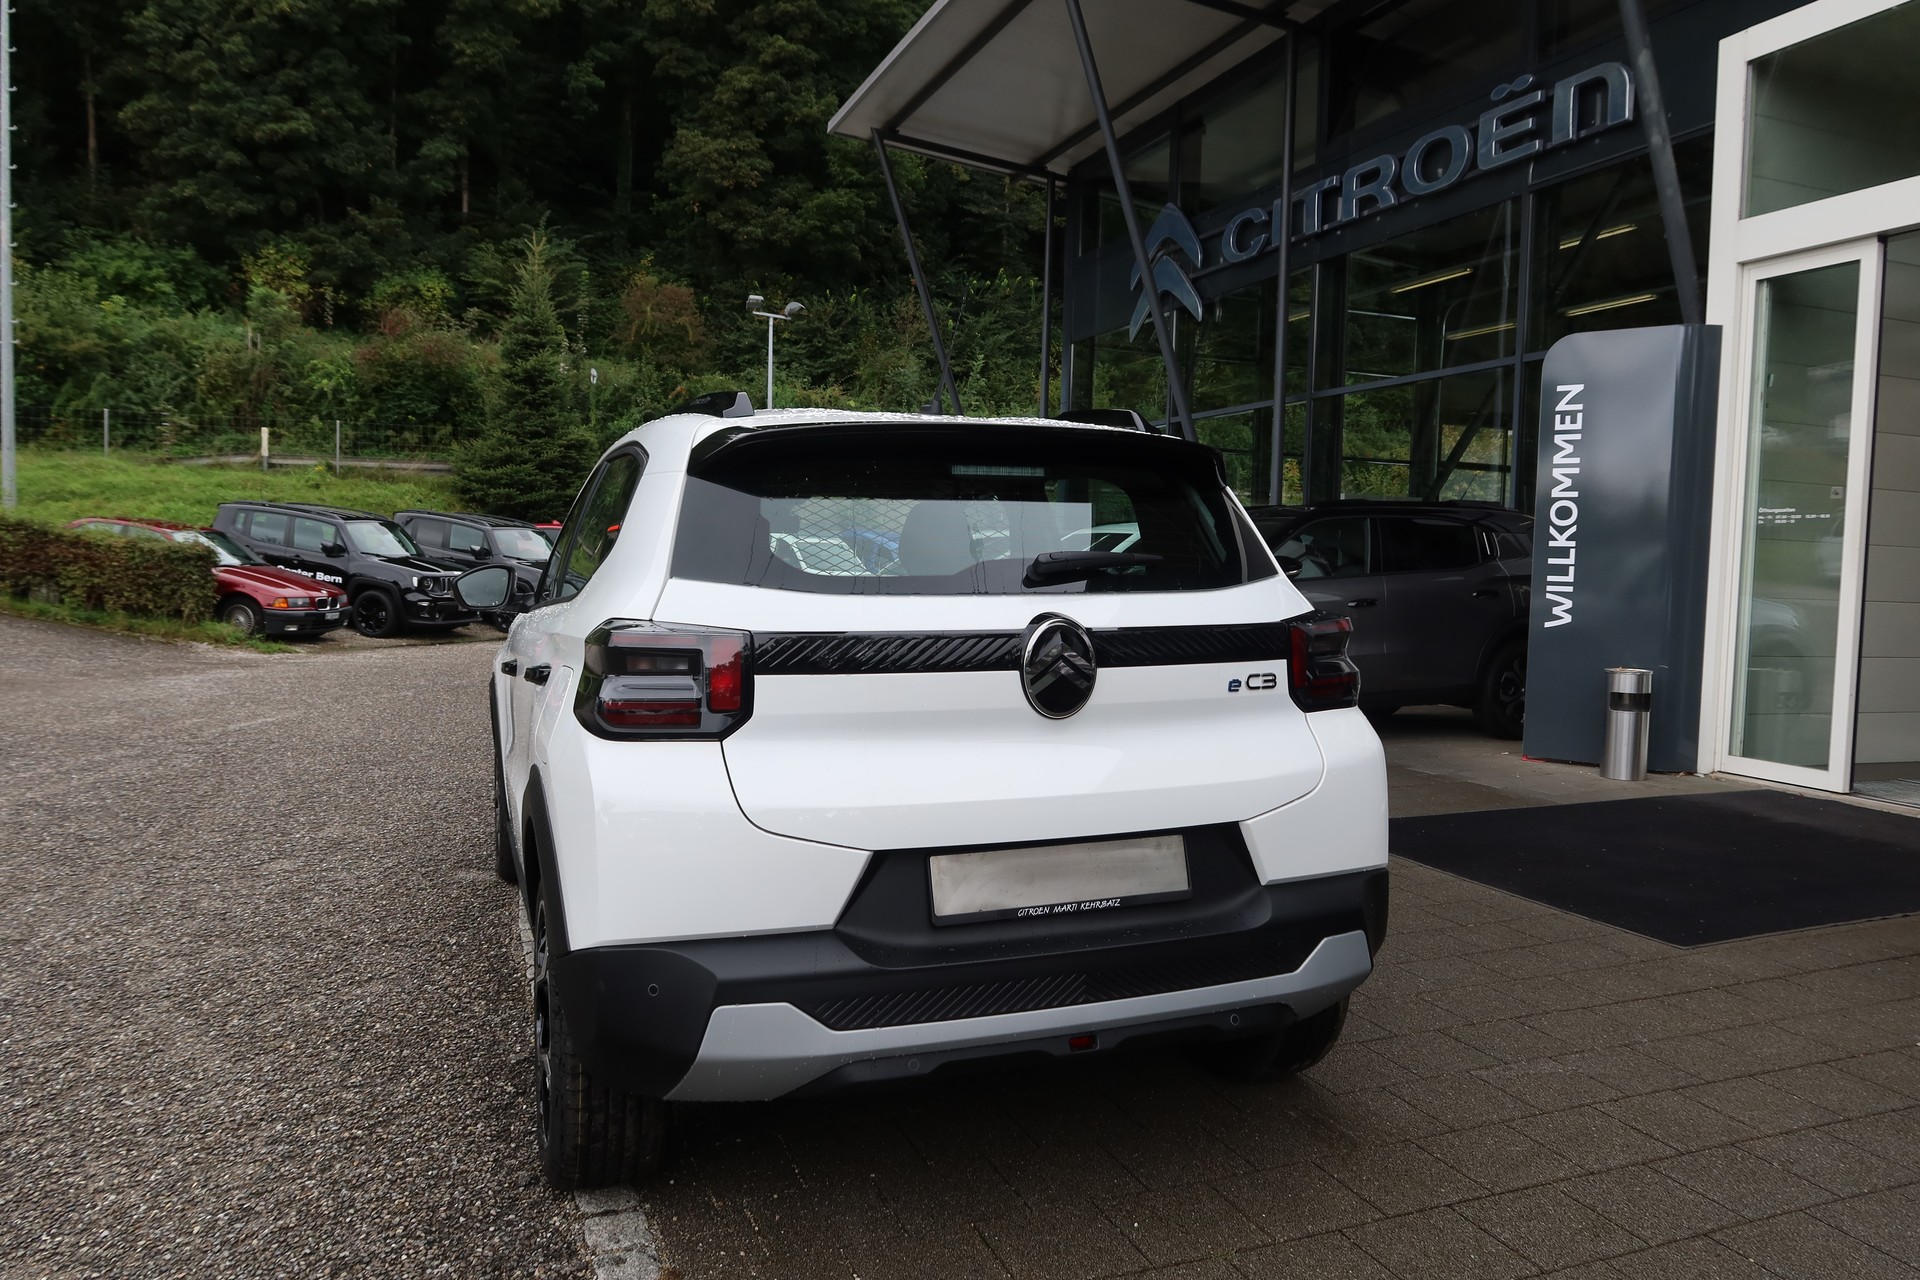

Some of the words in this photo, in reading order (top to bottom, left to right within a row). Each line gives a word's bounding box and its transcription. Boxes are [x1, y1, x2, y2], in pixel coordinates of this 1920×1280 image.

[1544, 383, 1585, 628] WILLKOMMEN
[316, 571, 343, 584] Bern
[1017, 906, 1050, 917] CITROEN
[1053, 903, 1078, 914] MARTI
[1080, 898, 1121, 911] KEHRSATZ
